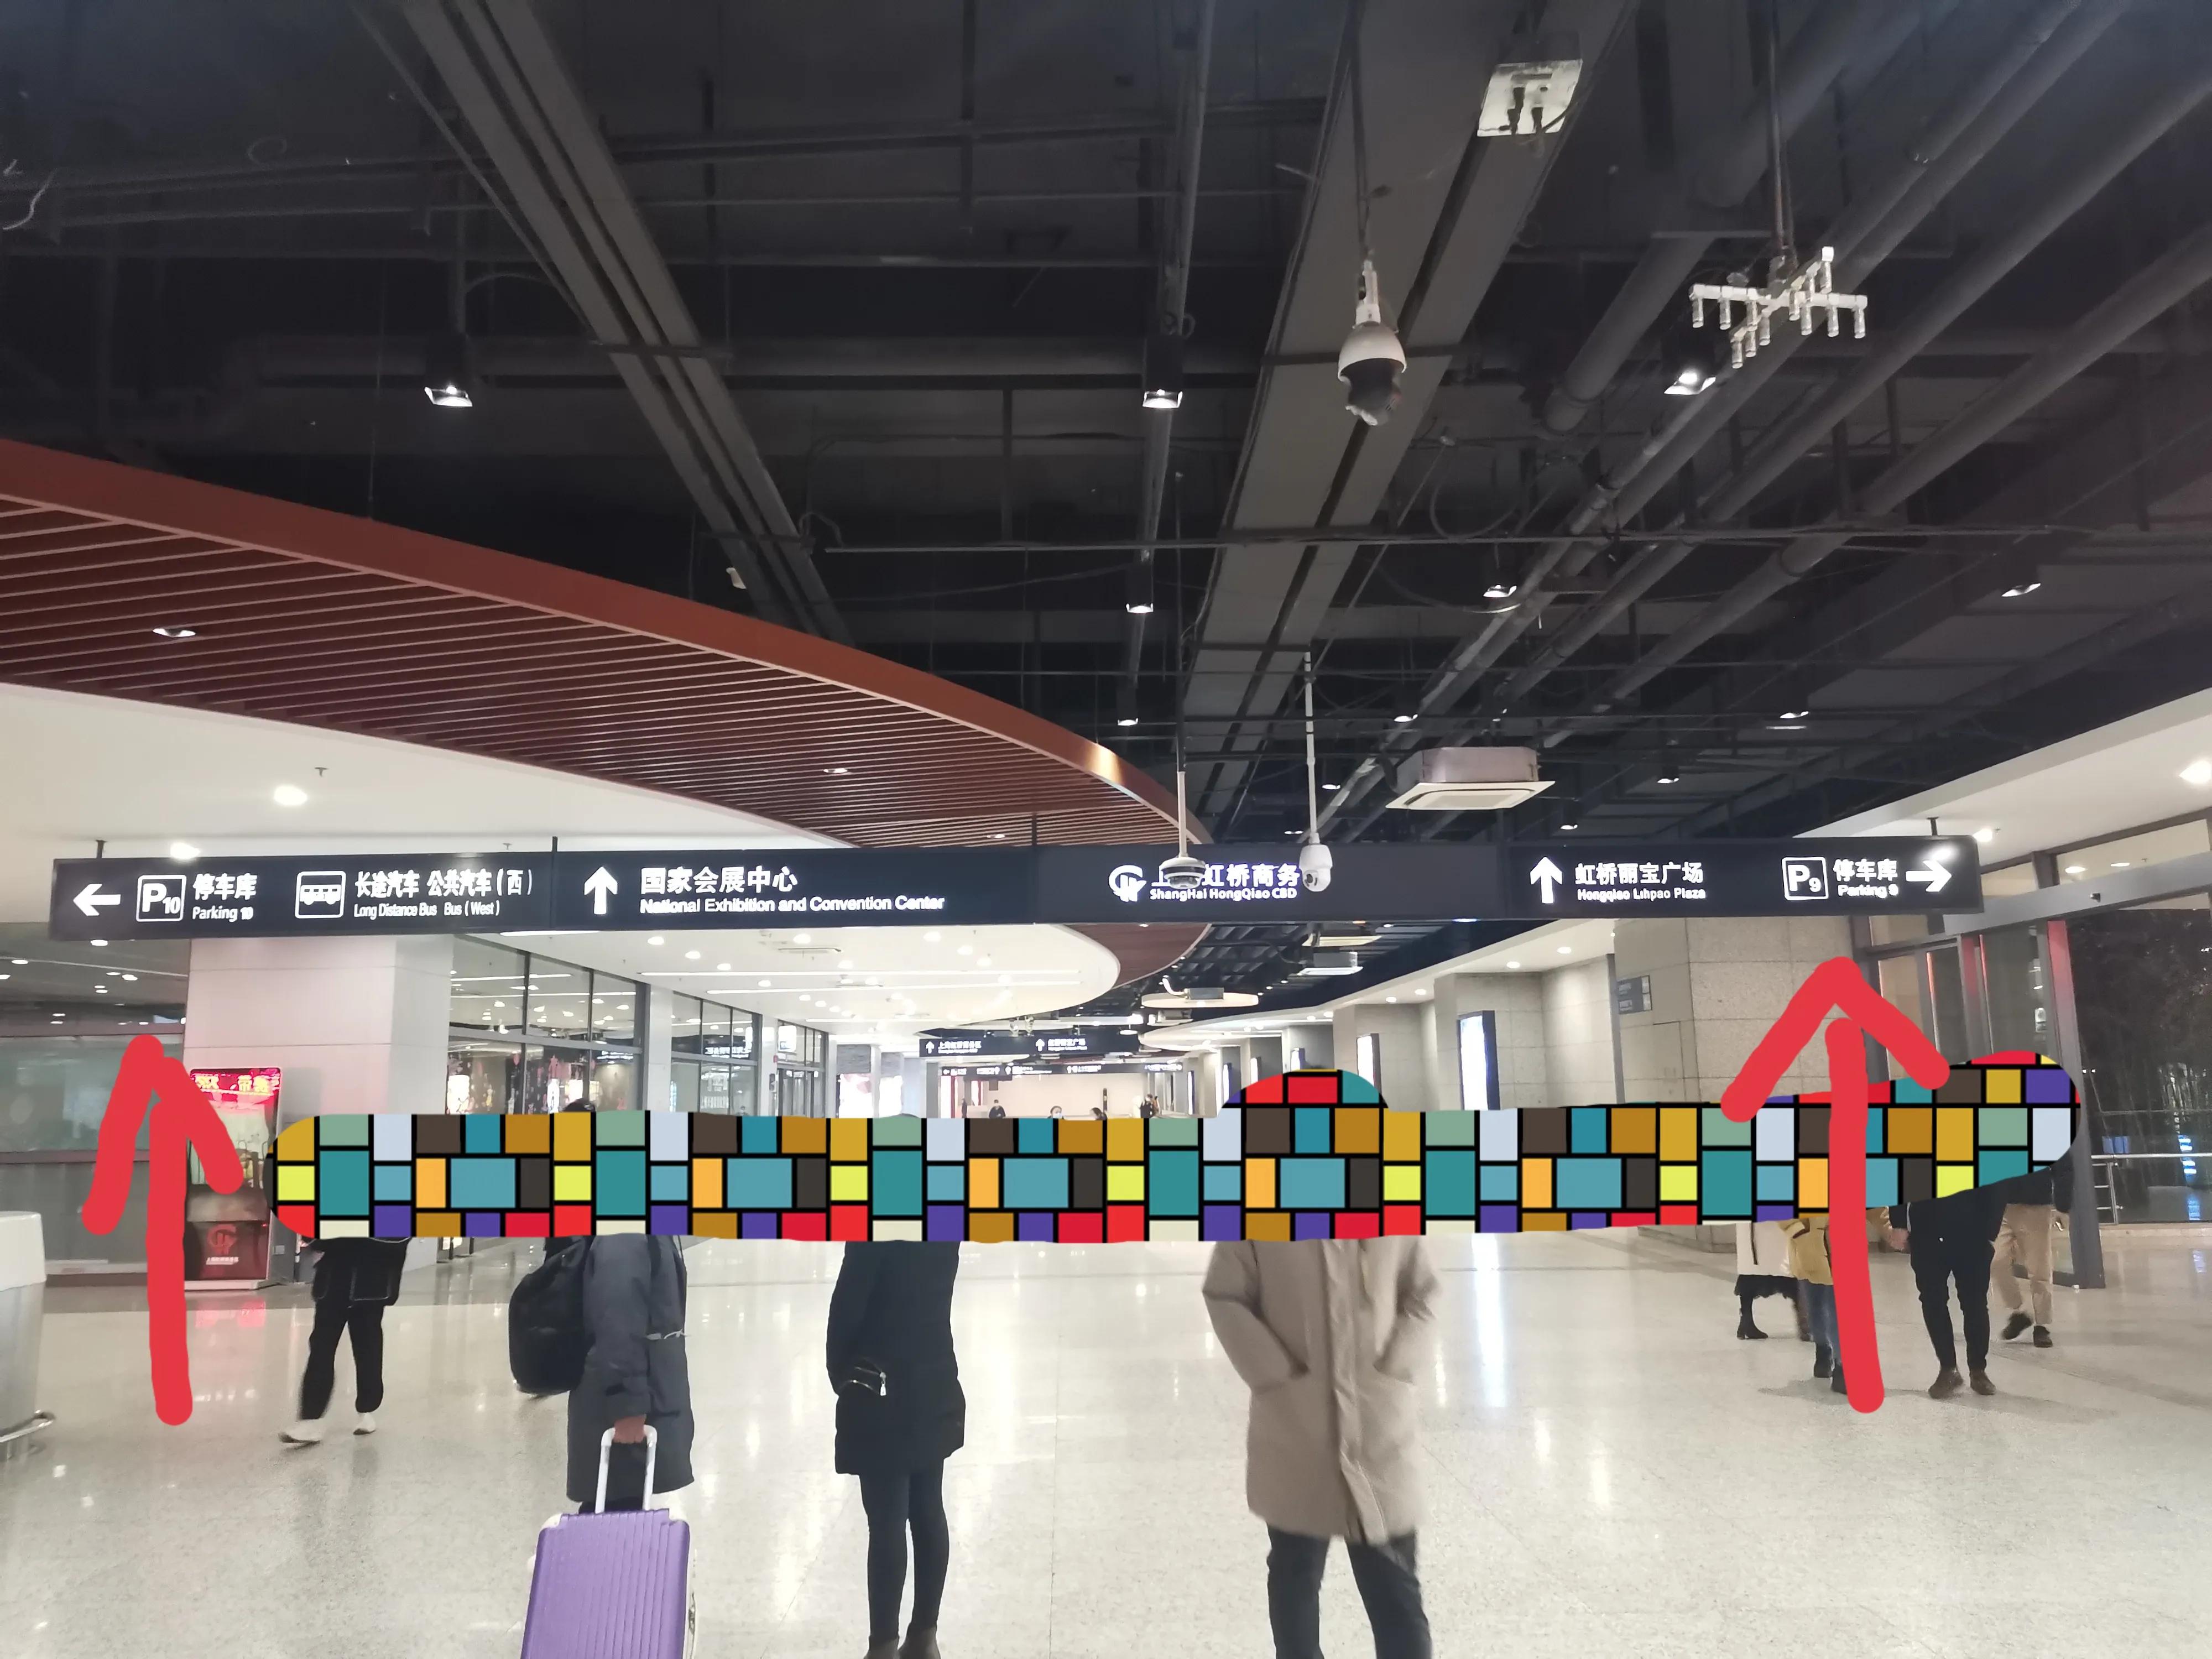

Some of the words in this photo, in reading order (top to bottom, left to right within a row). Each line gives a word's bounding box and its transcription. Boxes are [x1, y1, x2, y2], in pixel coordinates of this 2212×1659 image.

[1575, 862, 1704, 885] 虹桥丽宝广场
[1833, 858, 1898, 881] 停车库
[192, 873, 258, 900] 停车库
[354, 870, 420, 898] 长途汽车
[641, 865, 798, 895] 国家会展中心
[1150, 888, 1207, 902] ShangHai
[1209, 887, 1270, 901] HongQiao
[1271, 887, 1297, 899] CBD
[1577, 888, 1631, 902] Hongqiao
[1673, 887, 1706, 899] Plaza
[1838, 884, 1887, 899] Parking
[1888, 883, 1899, 896] 9
[192, 905, 238, 922] Parking
[240, 906, 254, 920] 10
[353, 904, 377, 920] Long
[378, 902, 418, 917] Distance
[419, 902, 437, 916] Bus
[444, 901, 462, 916] Bus
[640, 898, 701, 914] National
[705, 897, 775, 912] Exhibition
[778, 896, 807, 912] and
[809, 895, 892, 911] Convention
[894, 895, 945, 910] Center
